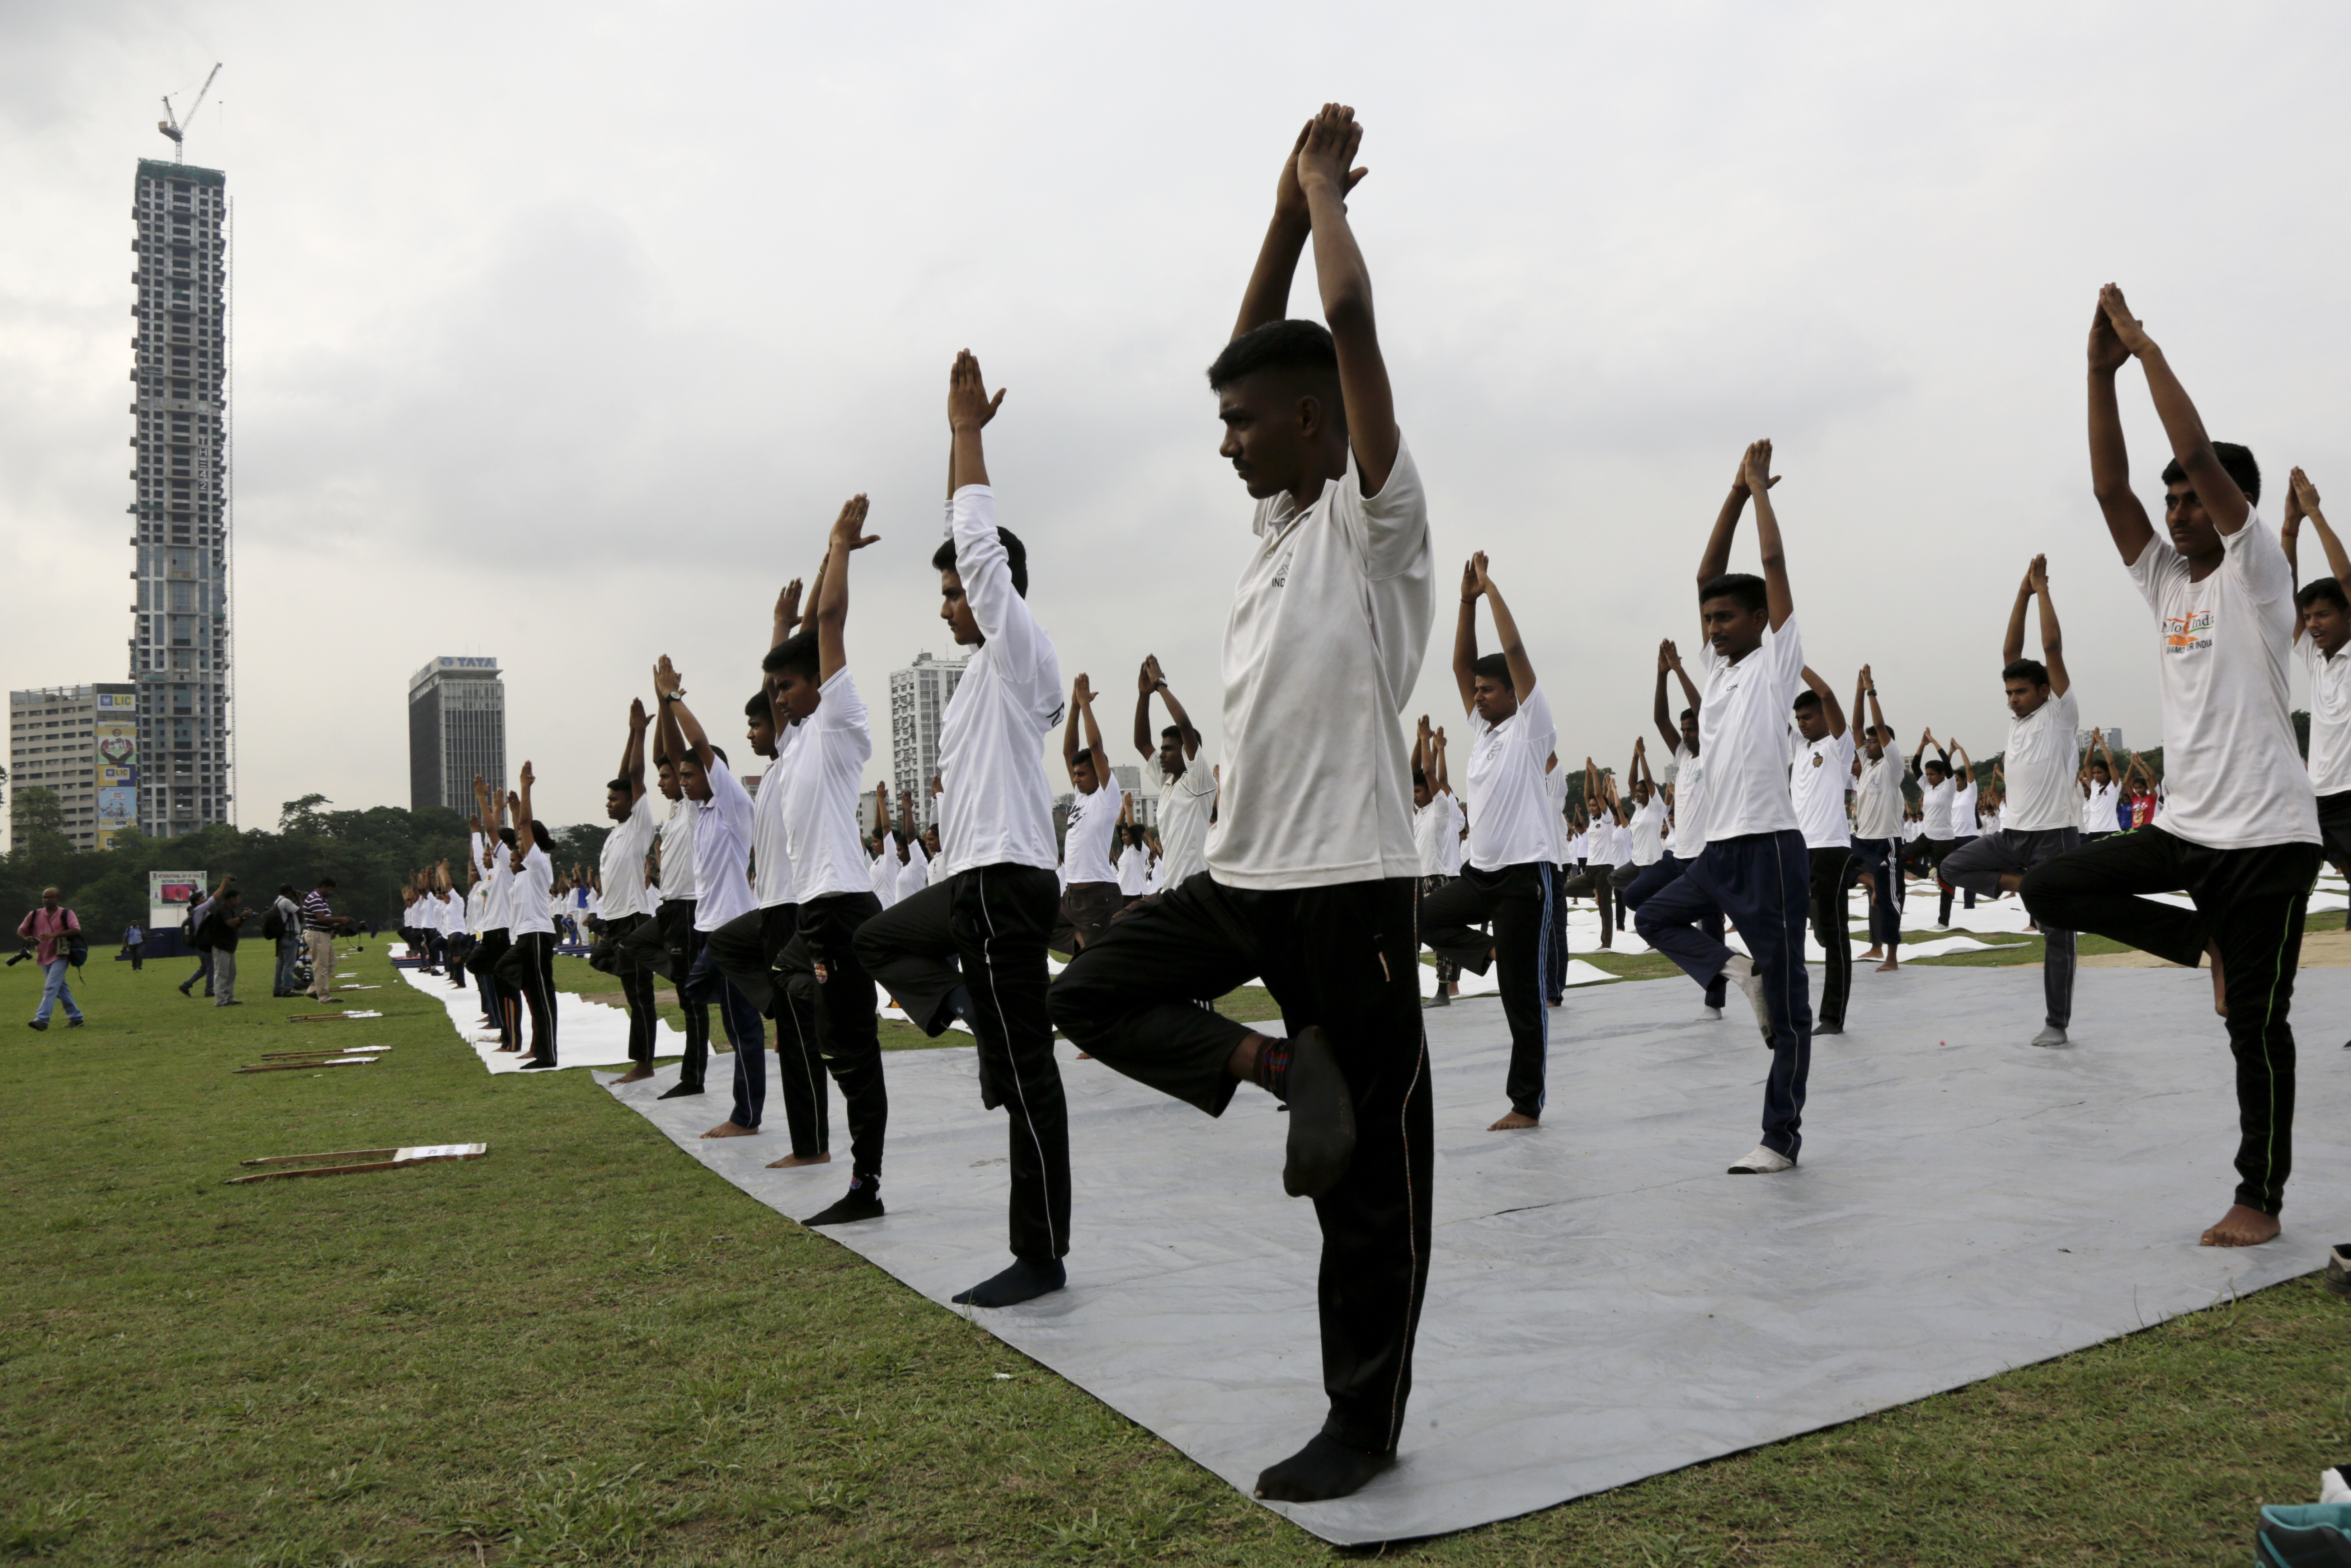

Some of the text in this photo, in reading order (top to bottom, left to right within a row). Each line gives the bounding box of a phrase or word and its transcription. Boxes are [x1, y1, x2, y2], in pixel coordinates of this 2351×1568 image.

[2195, 639, 2212, 650] INDIA
[457, 658, 495, 667] TATA
[115, 696, 131, 705] LIC
